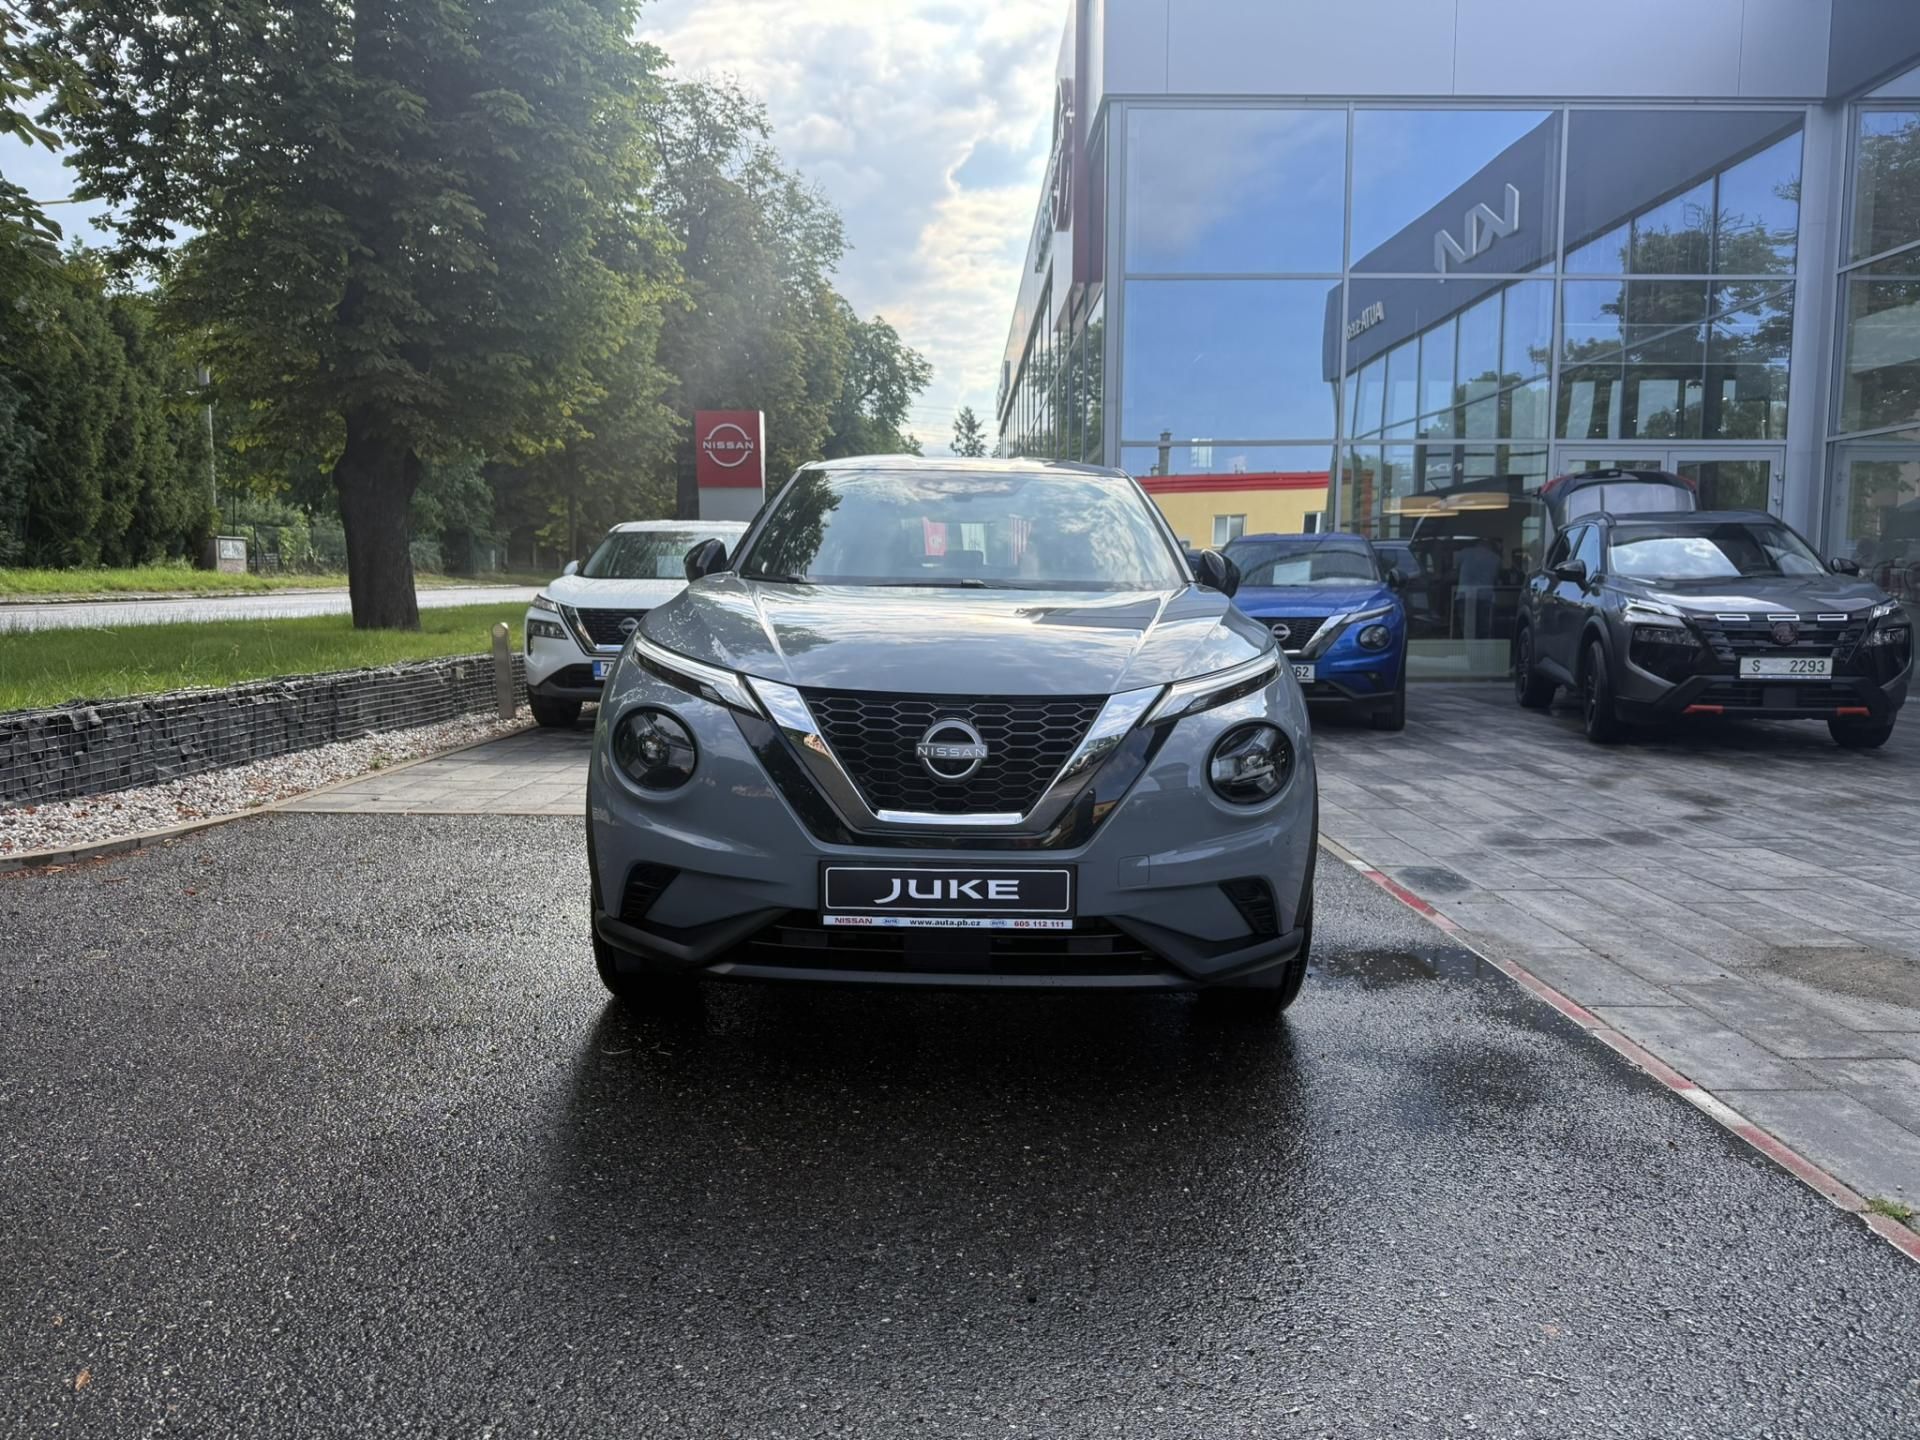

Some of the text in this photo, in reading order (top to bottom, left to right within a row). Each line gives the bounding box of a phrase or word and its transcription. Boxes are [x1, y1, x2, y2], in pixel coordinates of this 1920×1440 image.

[703, 441, 753, 449] NISSAN
[1752, 660, 1825, 673] S 2293
[917, 746, 986, 757] NISSAN
[873, 878, 1020, 904] JUKE
[834, 917, 873, 925] NISSAN
[909, 919, 981, 928] www.auta.pb.cz
